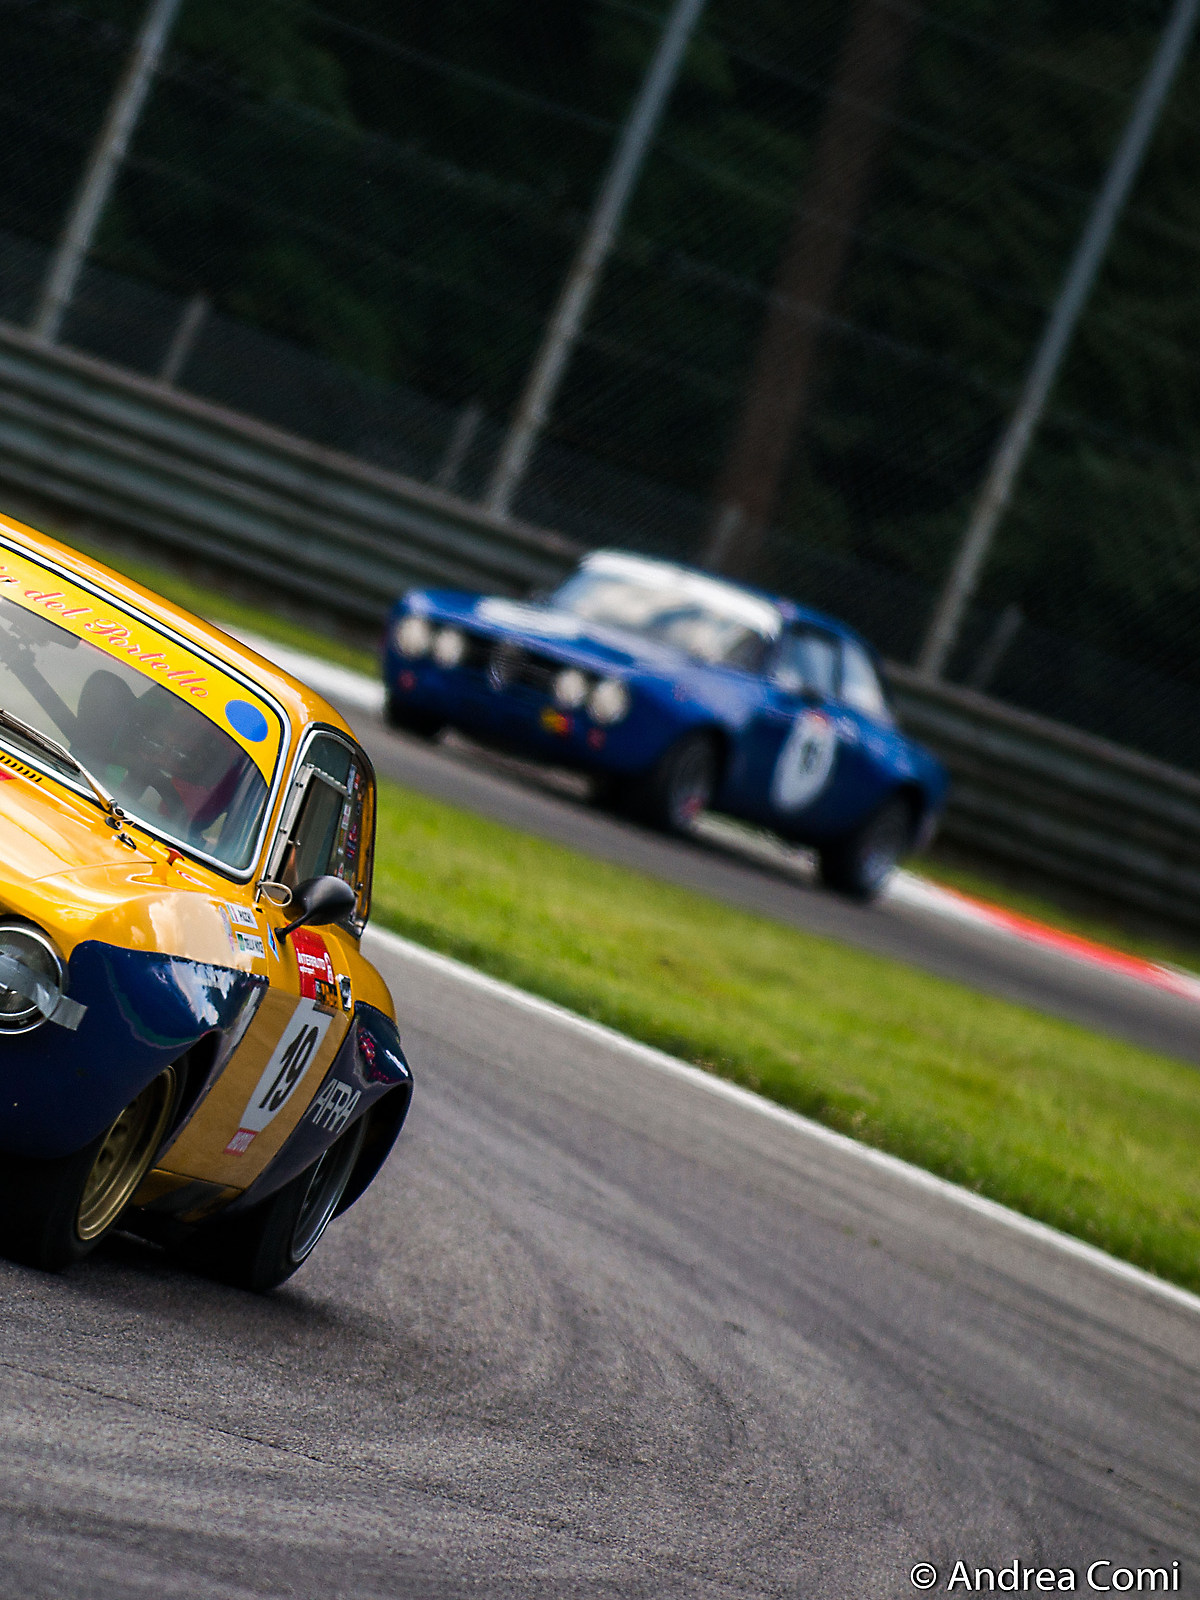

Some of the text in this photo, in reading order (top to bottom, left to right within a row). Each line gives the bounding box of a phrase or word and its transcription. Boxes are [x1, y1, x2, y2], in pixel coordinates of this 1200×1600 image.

[24, 590, 93, 618] del
[84, 618, 209, 699] Portello
[258, 1023, 319, 1112] 19
[303, 1078, 362, 1134] AFRA
